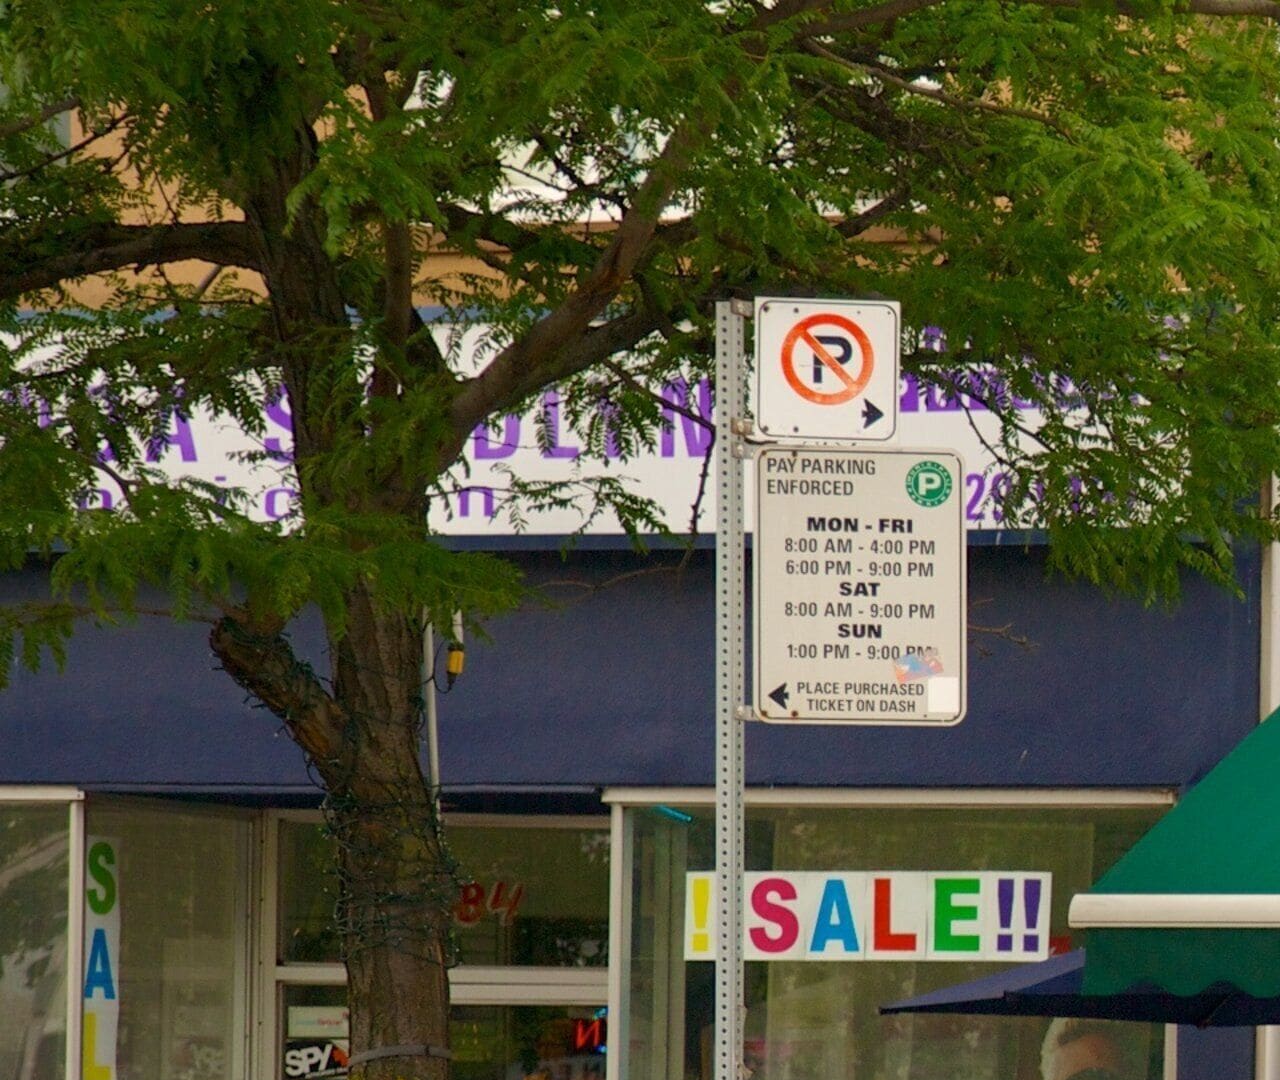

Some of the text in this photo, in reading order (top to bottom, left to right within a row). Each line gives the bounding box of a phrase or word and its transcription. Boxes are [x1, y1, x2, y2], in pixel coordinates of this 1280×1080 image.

[767, 456, 875, 474] PAY PARKING
[768, 480, 853, 495] ENFORCED
[808, 517, 858, 532] MON
[879, 519, 912, 533] FRI
[785, 538, 817, 552] 8:00
[825, 539, 852, 553] AM
[871, 540, 902, 554] 4:00
[909, 540, 934, 554] PM
[786, 560, 818, 574] 6:00
[825, 561, 850, 574] PM
[869, 562, 901, 576] 9:00
[908, 562, 933, 576] PM
[840, 582, 880, 596] SAT
[785, 602, 817, 616] 8:00
[825, 603, 851, 617] AM
[871, 604, 902, 618] 9:00
[909, 604, 934, 618] PM
[839, 624, 881, 638] SUN
[788, 644, 817, 658] 1:00
[824, 644, 849, 658] PM
[868, 646, 899, 660] 9:00
[798, 682, 924, 695] PLACE PURCHASED
[808, 699, 915, 712] TICKET ON DASH
[285, 1044, 333, 1076] SPY
